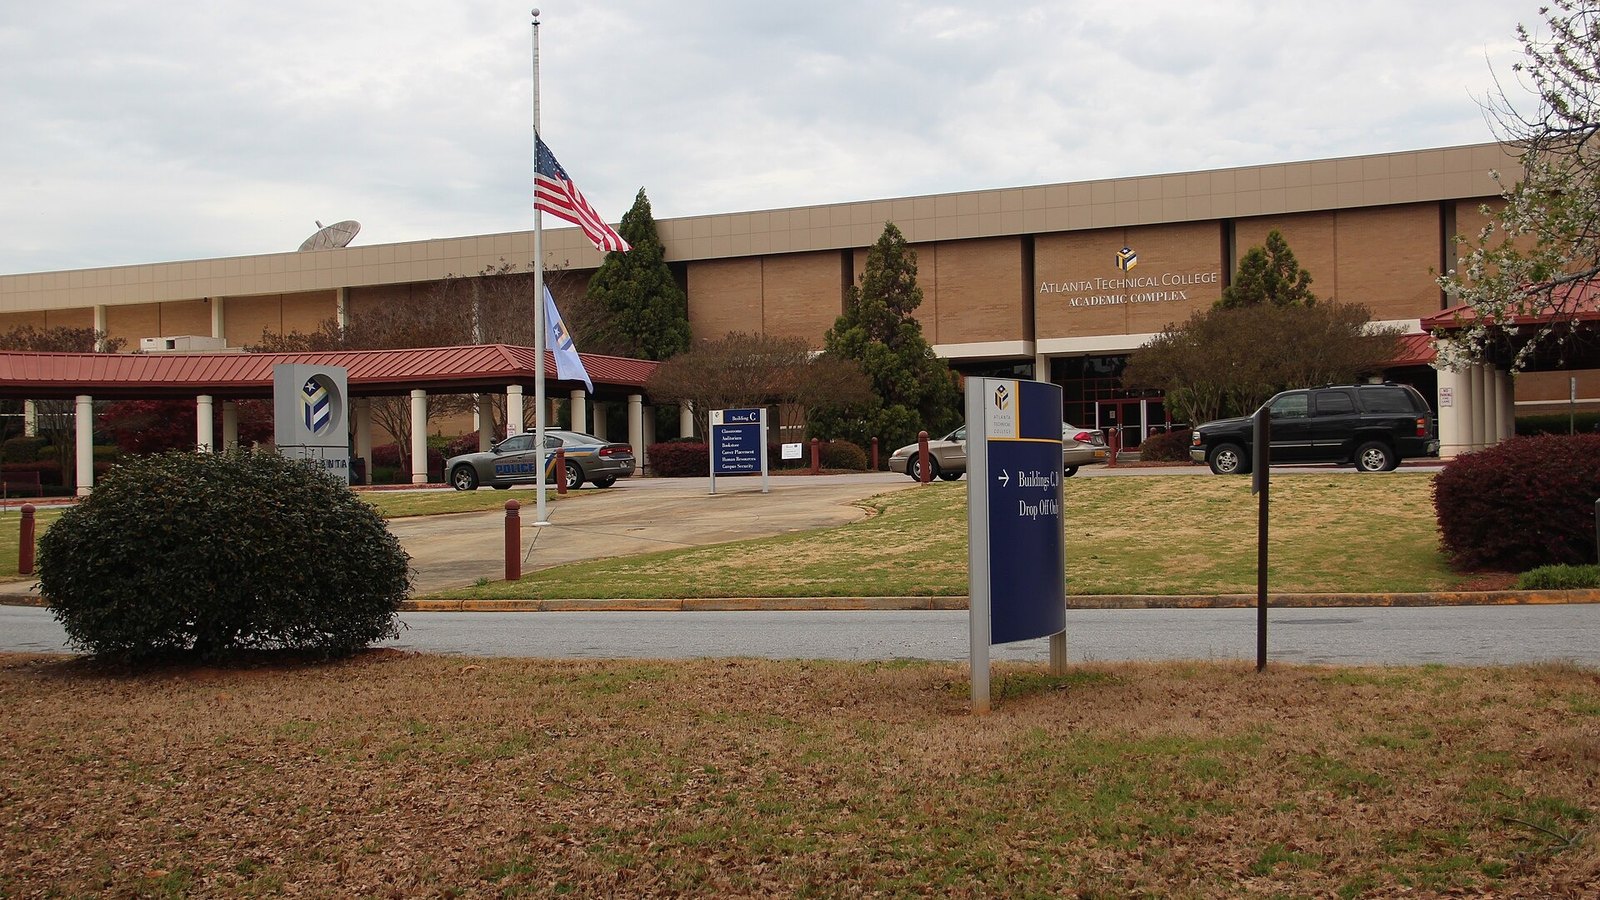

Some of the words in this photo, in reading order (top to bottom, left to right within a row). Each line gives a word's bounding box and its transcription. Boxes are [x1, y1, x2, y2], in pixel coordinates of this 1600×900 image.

[1039, 281, 1093, 294] ATLANTA
[1094, 276, 1159, 291] TECHNICAL
[1161, 272, 1217, 286] COLLEGE
[1068, 294, 1128, 307] ACADEMIC
[1130, 290, 1187, 303] COMPLEX
[750, 411, 756, 421] C
[495, 463, 535, 474] POLICE
[1018, 471, 1050, 491] Buildings
[1019, 500, 1038, 520] Drop
[1039, 499, 1050, 515] Off
